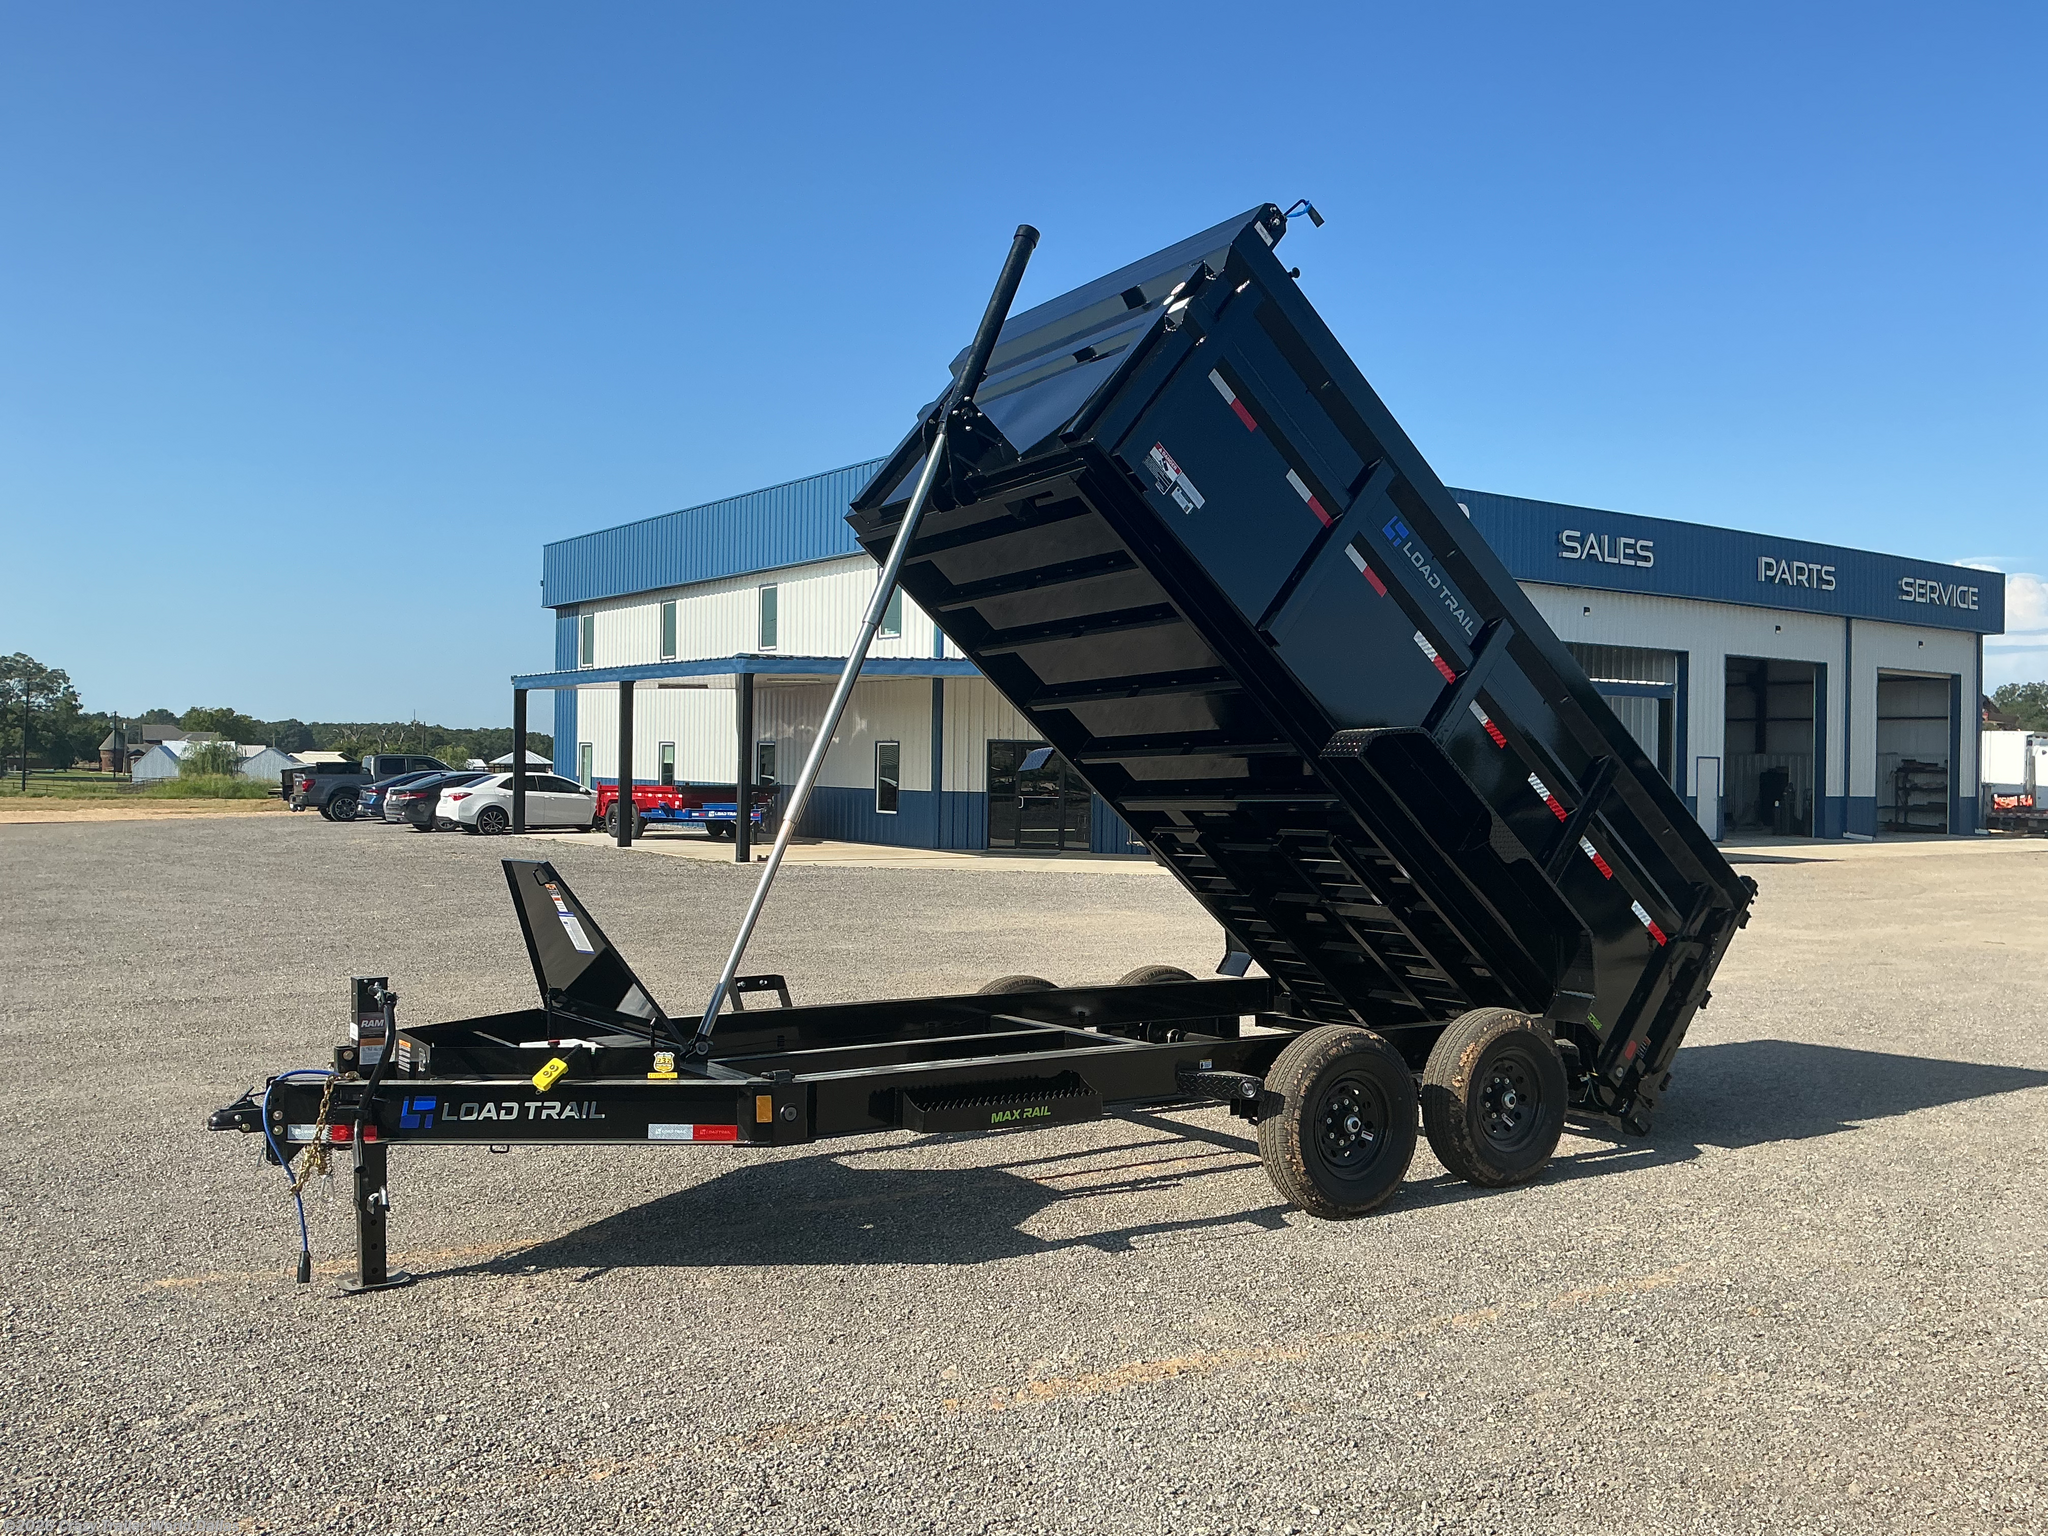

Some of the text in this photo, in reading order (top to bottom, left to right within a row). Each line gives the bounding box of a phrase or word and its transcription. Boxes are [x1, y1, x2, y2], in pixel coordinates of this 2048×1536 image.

[1560, 529, 1654, 568] SALES
[1402, 541, 1441, 589] LOAD
[1440, 585, 1473, 637] TRAIL
[1757, 556, 1836, 591] PARTS
[1899, 577, 1979, 610] SERVICE
[360, 1019, 385, 1028] RAM
[441, 1102, 519, 1121] LOAD
[524, 1101, 606, 1120] TRAIL
[991, 1105, 1051, 1124] MAX RAIL
